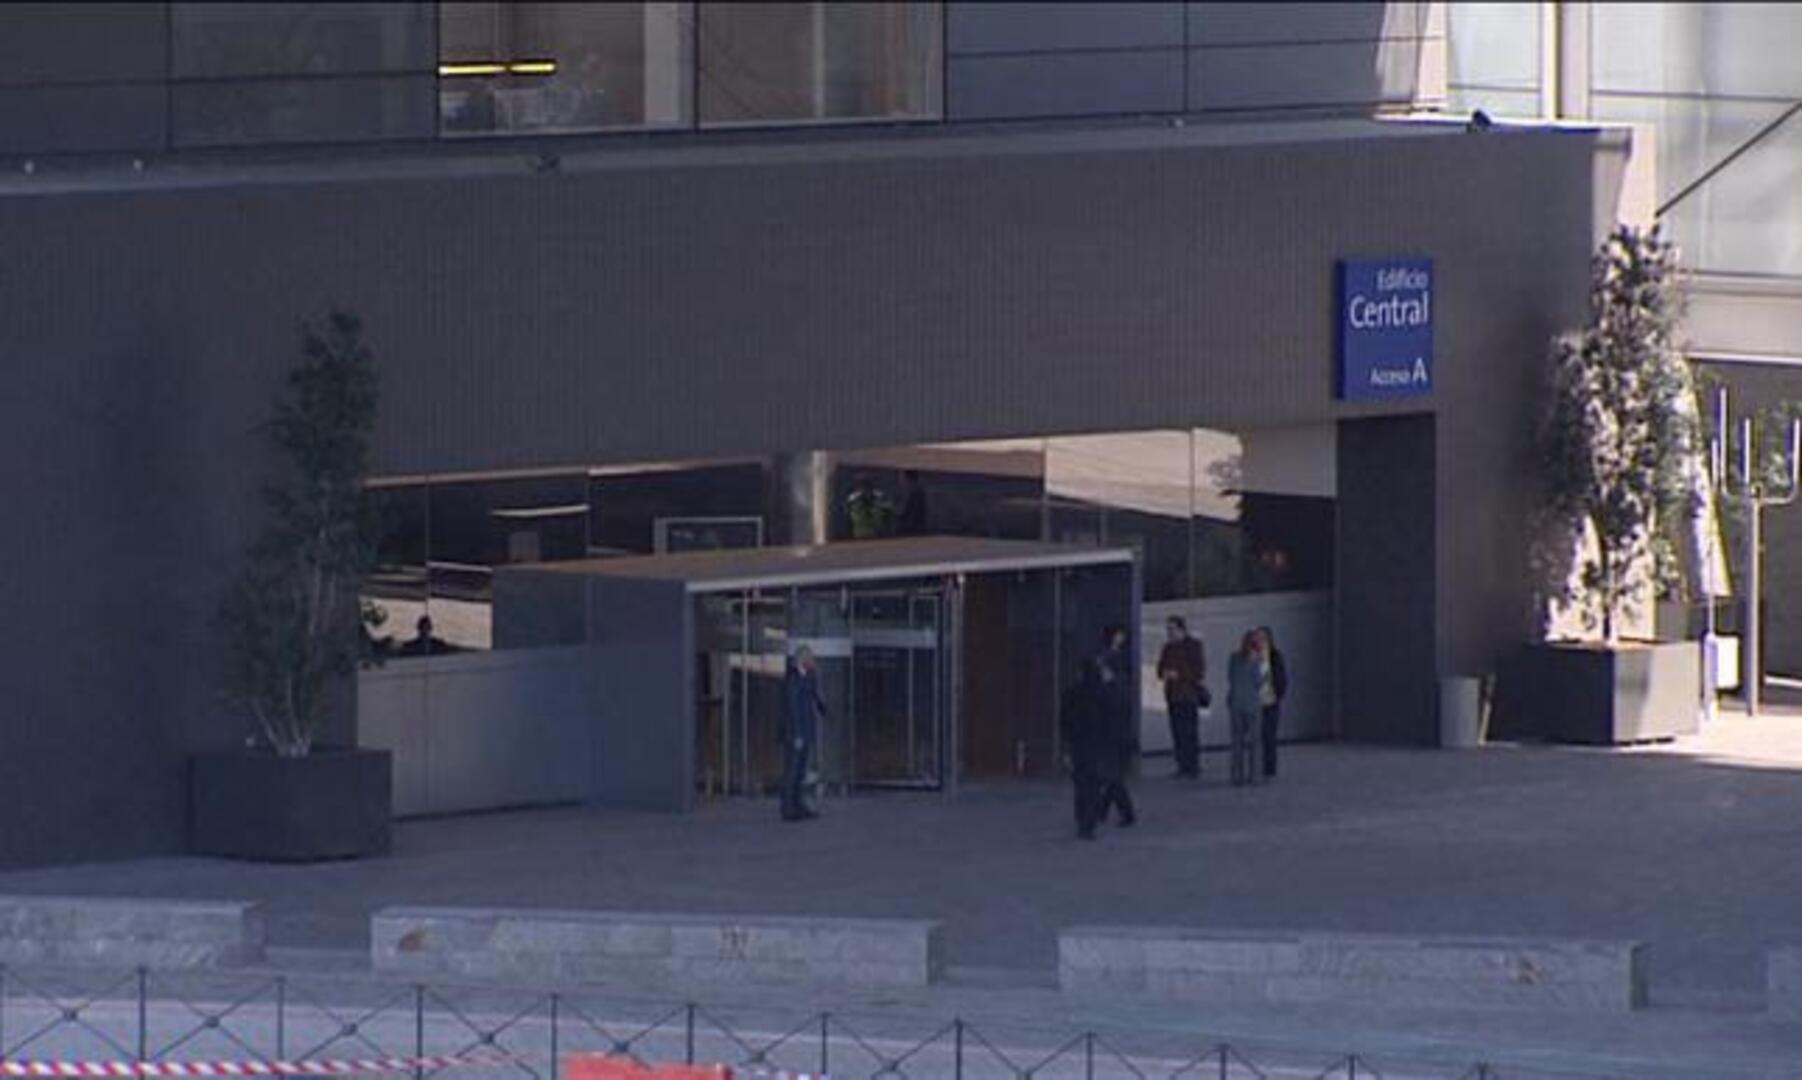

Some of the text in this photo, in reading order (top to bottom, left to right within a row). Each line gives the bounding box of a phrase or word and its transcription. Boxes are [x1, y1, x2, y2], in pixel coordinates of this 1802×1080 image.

[1377, 268, 1428, 291] Edificio
[1350, 291, 1428, 328] Central
[1371, 357, 1428, 385] Acceso A
